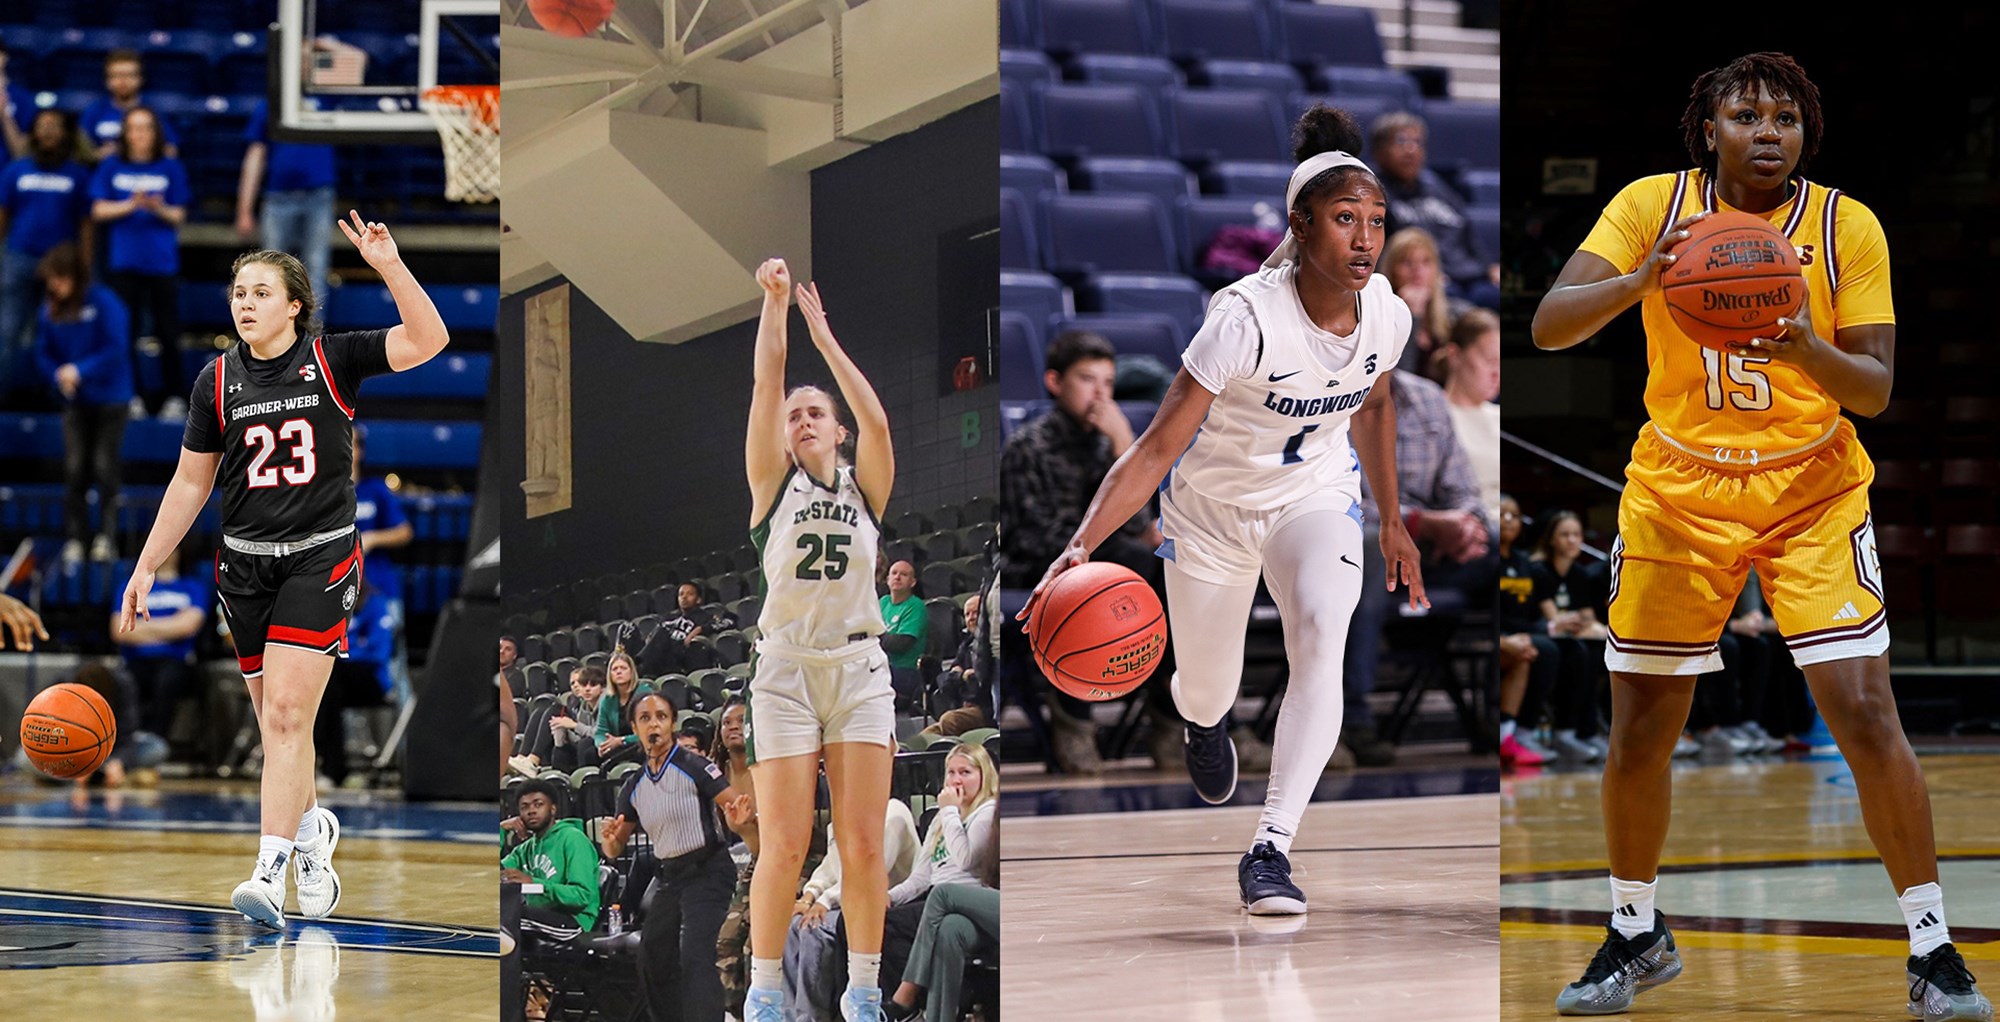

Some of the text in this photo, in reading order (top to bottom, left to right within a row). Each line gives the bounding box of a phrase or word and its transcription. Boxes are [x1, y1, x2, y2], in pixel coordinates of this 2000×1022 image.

[1705, 250, 1785, 271] LEGACY
[1703, 283, 1791, 311] SPALDING
[1700, 346, 1772, 411] 15
[231, 394, 320, 420] GARDNER-WEBB
[961, 411, 981, 449] B
[1281, 423, 1321, 466] 1
[244, 418, 316, 489] 23
[796, 533, 851, 580] 25
[1102, 638, 1165, 678] LEGACY
[23, 730, 69, 746] LEGACY
